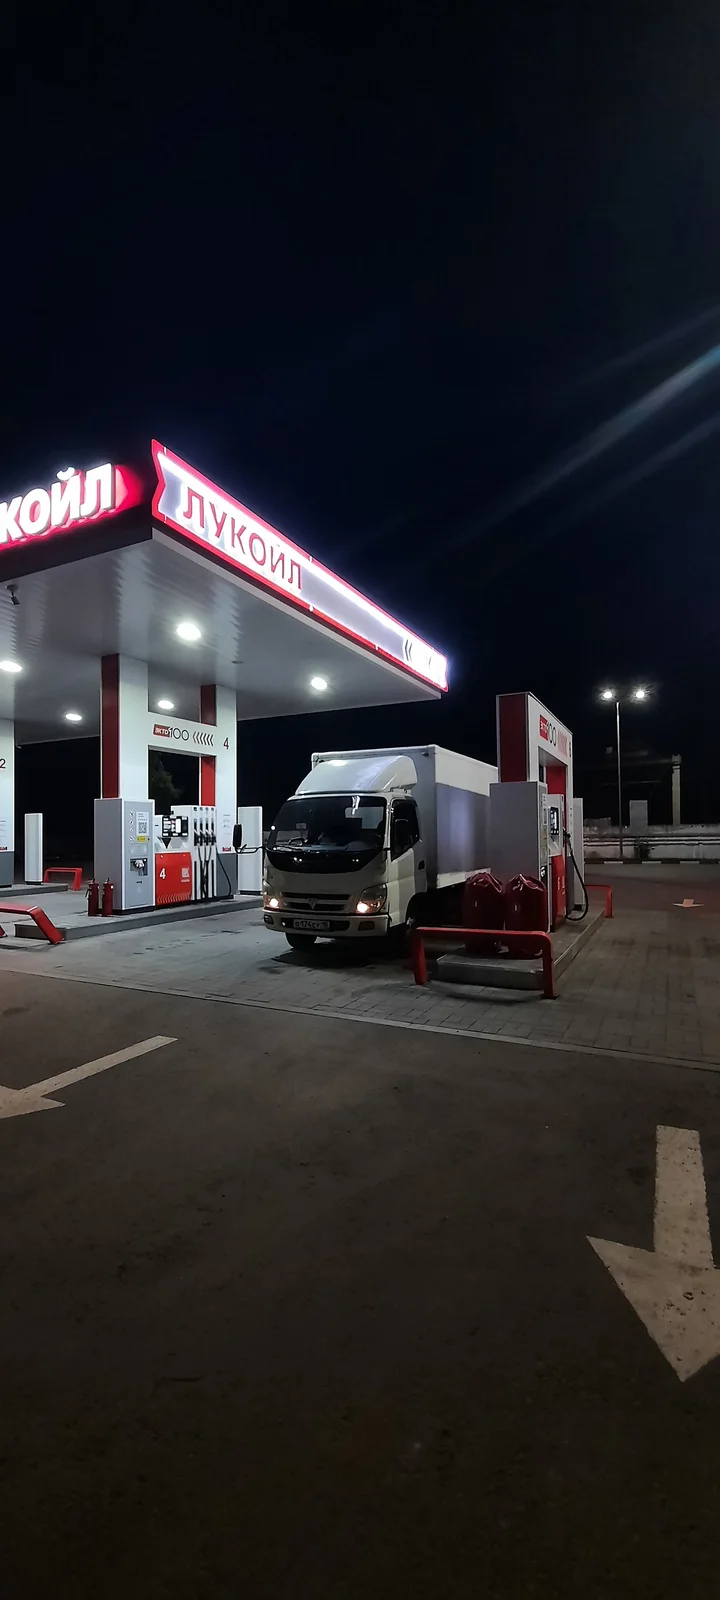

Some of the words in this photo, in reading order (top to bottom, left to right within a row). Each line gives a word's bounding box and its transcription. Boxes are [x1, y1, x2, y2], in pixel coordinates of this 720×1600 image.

[168, 727, 190, 741] 100
[223, 737, 230, 750] 4
[0, 758, 6, 769] 2
[159, 867, 166, 879] 4
